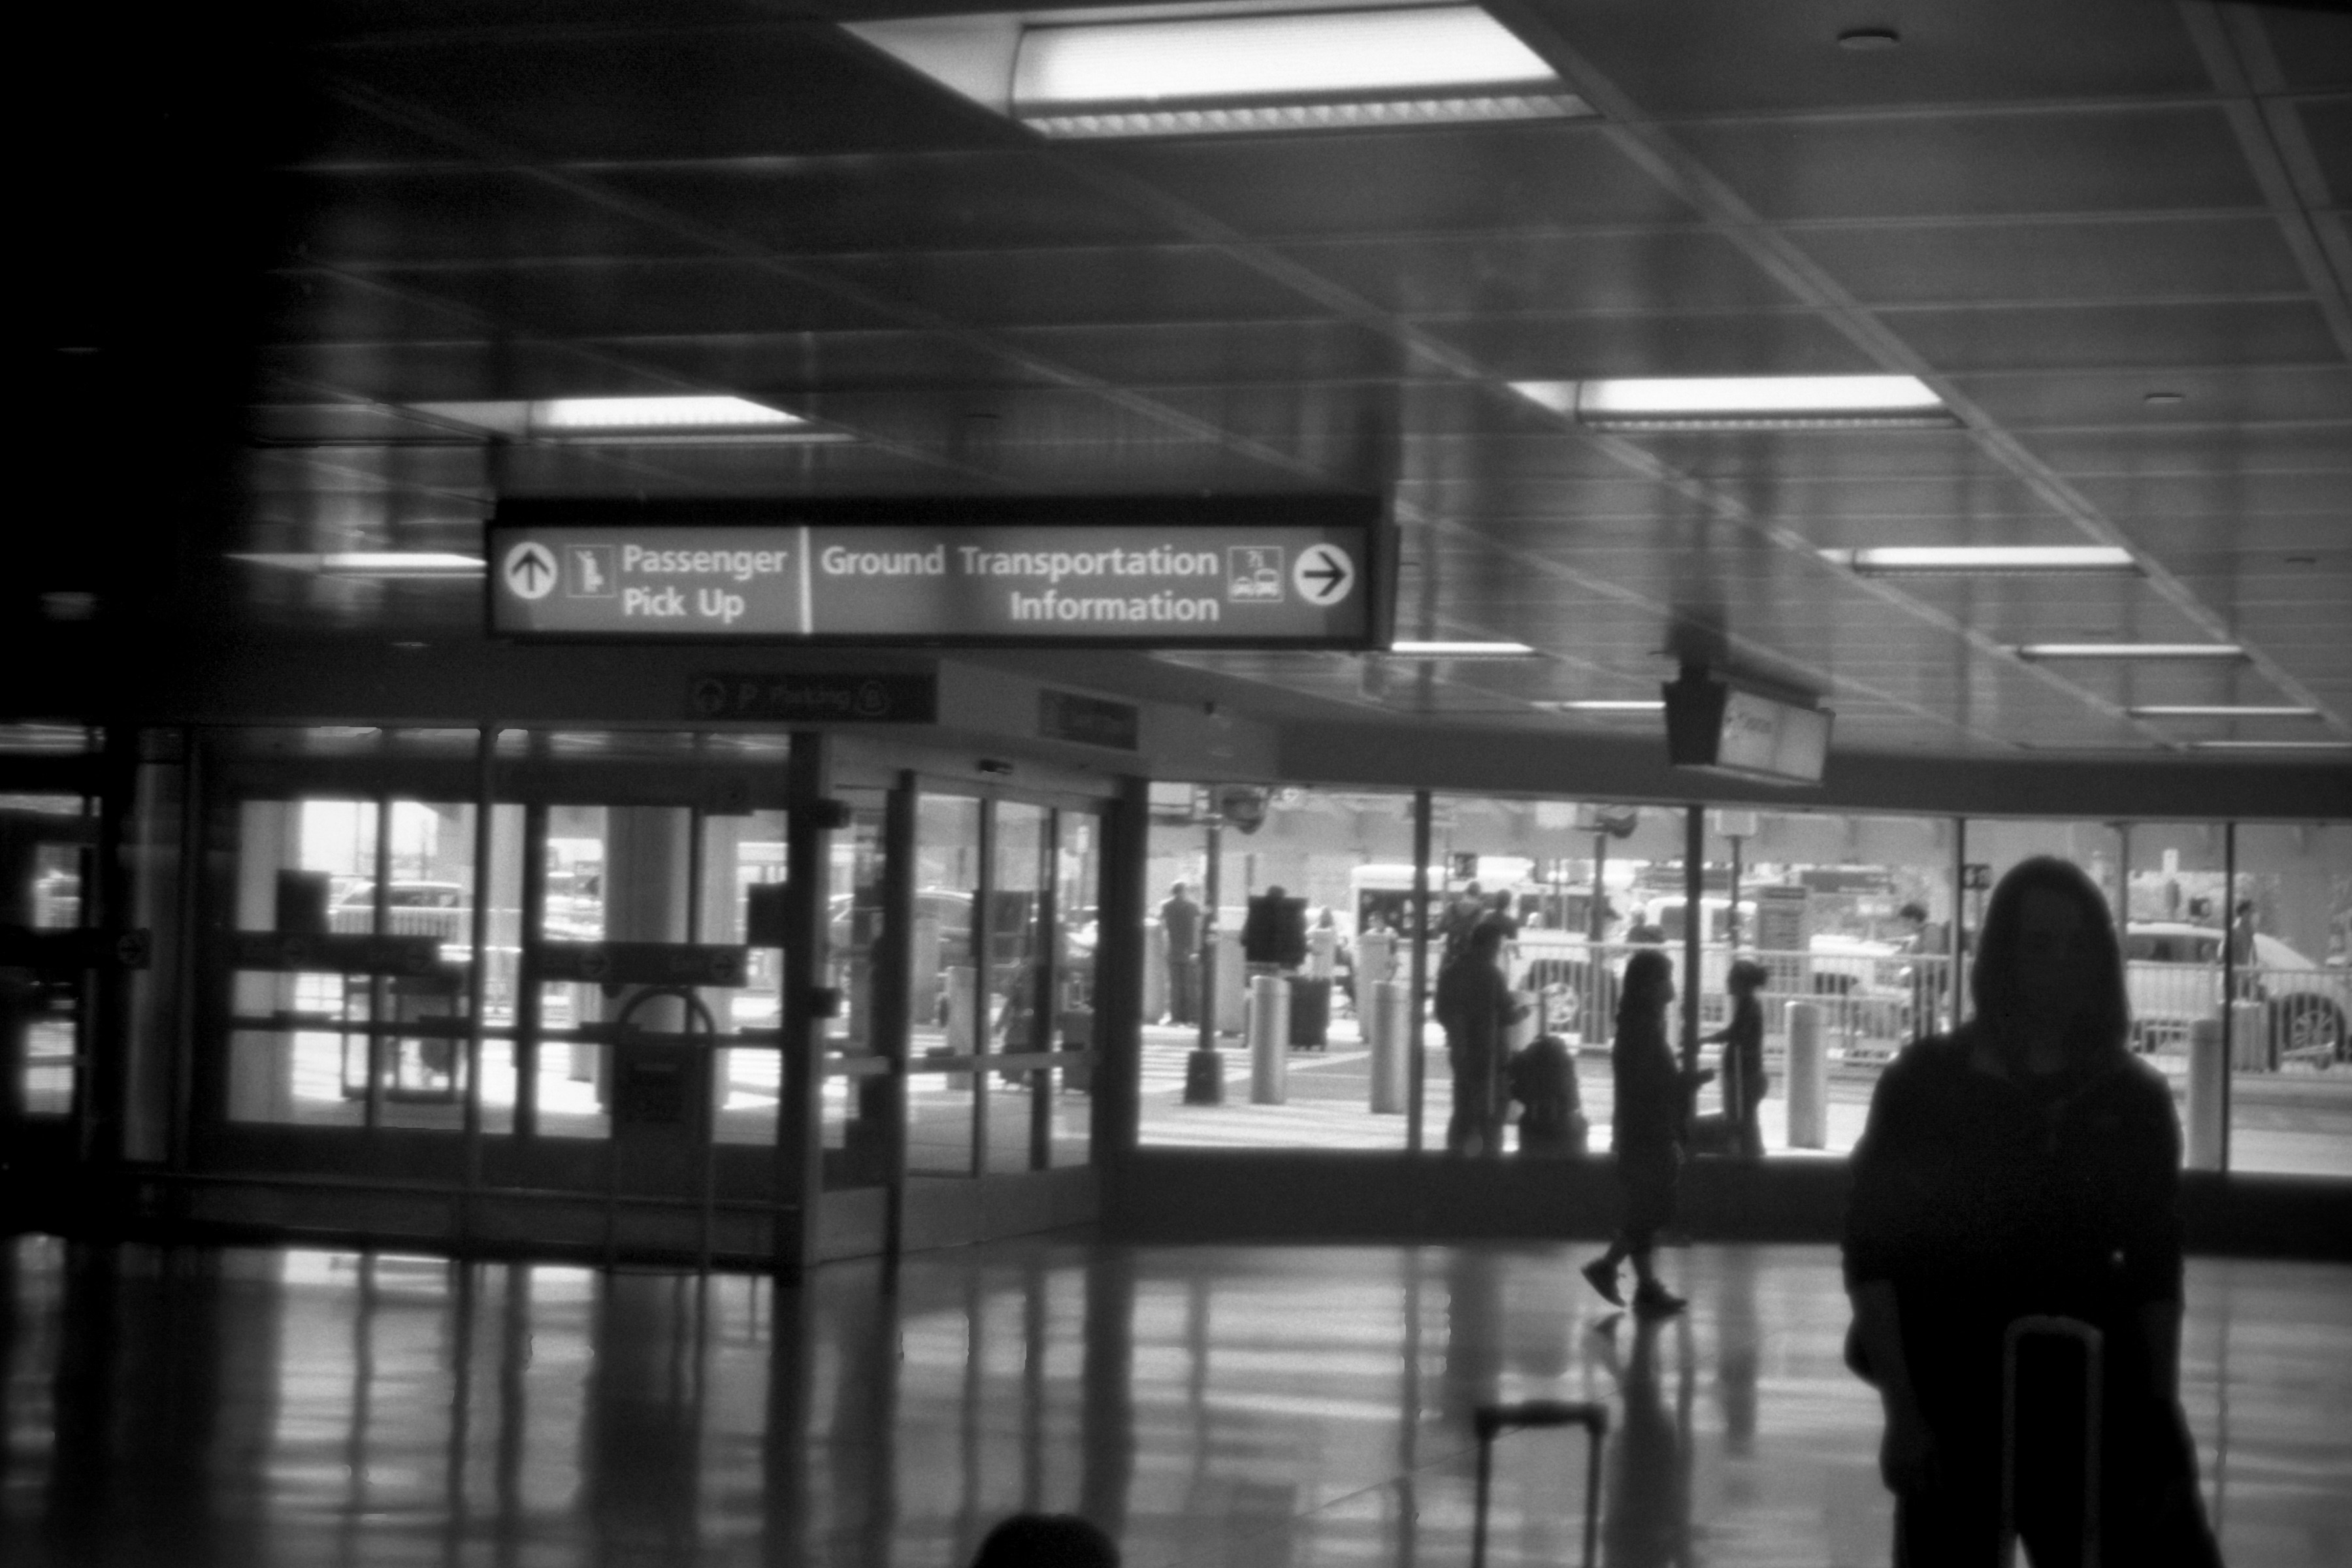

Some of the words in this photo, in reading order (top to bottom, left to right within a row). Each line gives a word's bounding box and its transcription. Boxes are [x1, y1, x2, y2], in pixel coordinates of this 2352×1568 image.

[623, 544, 787, 583] Passenger
[820, 544, 945, 577] Ground
[958, 544, 1219, 583] Transportation
[623, 586, 685, 617] Pick
[697, 587, 745, 624] Up
[1009, 589, 1220, 622] Information
